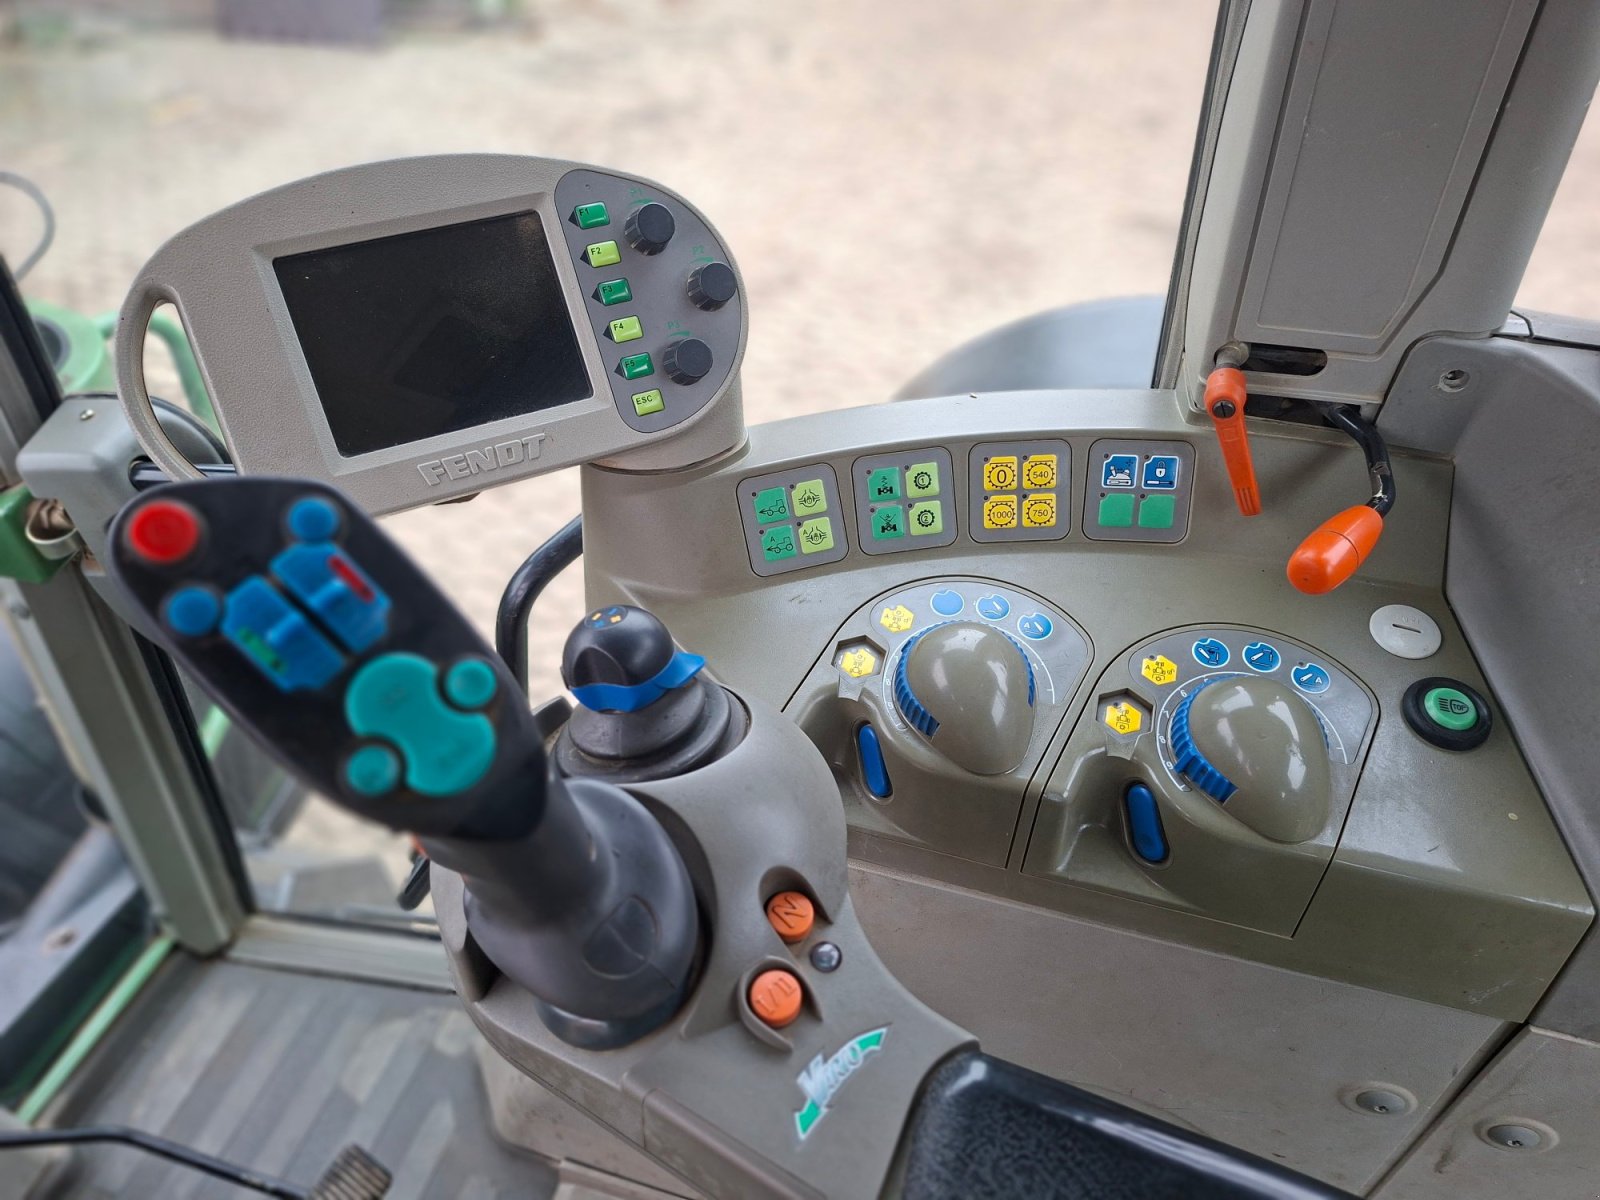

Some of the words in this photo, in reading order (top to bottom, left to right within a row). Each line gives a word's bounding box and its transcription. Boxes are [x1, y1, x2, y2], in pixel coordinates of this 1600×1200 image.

[579, 208, 589, 216] F1
[590, 247, 602, 255] F2
[602, 285, 613, 294] F3
[613, 322, 624, 331] F4
[624, 359, 636, 368] F5
[635, 394, 653, 406] ESC
[416, 432, 546, 487] FENDT
[1033, 471, 1049, 479] 540
[992, 510, 1013, 519] 1000
[1033, 509, 1049, 517] 750
[1315, 676, 1323, 685] A
[1452, 703, 1467, 711] TOP
